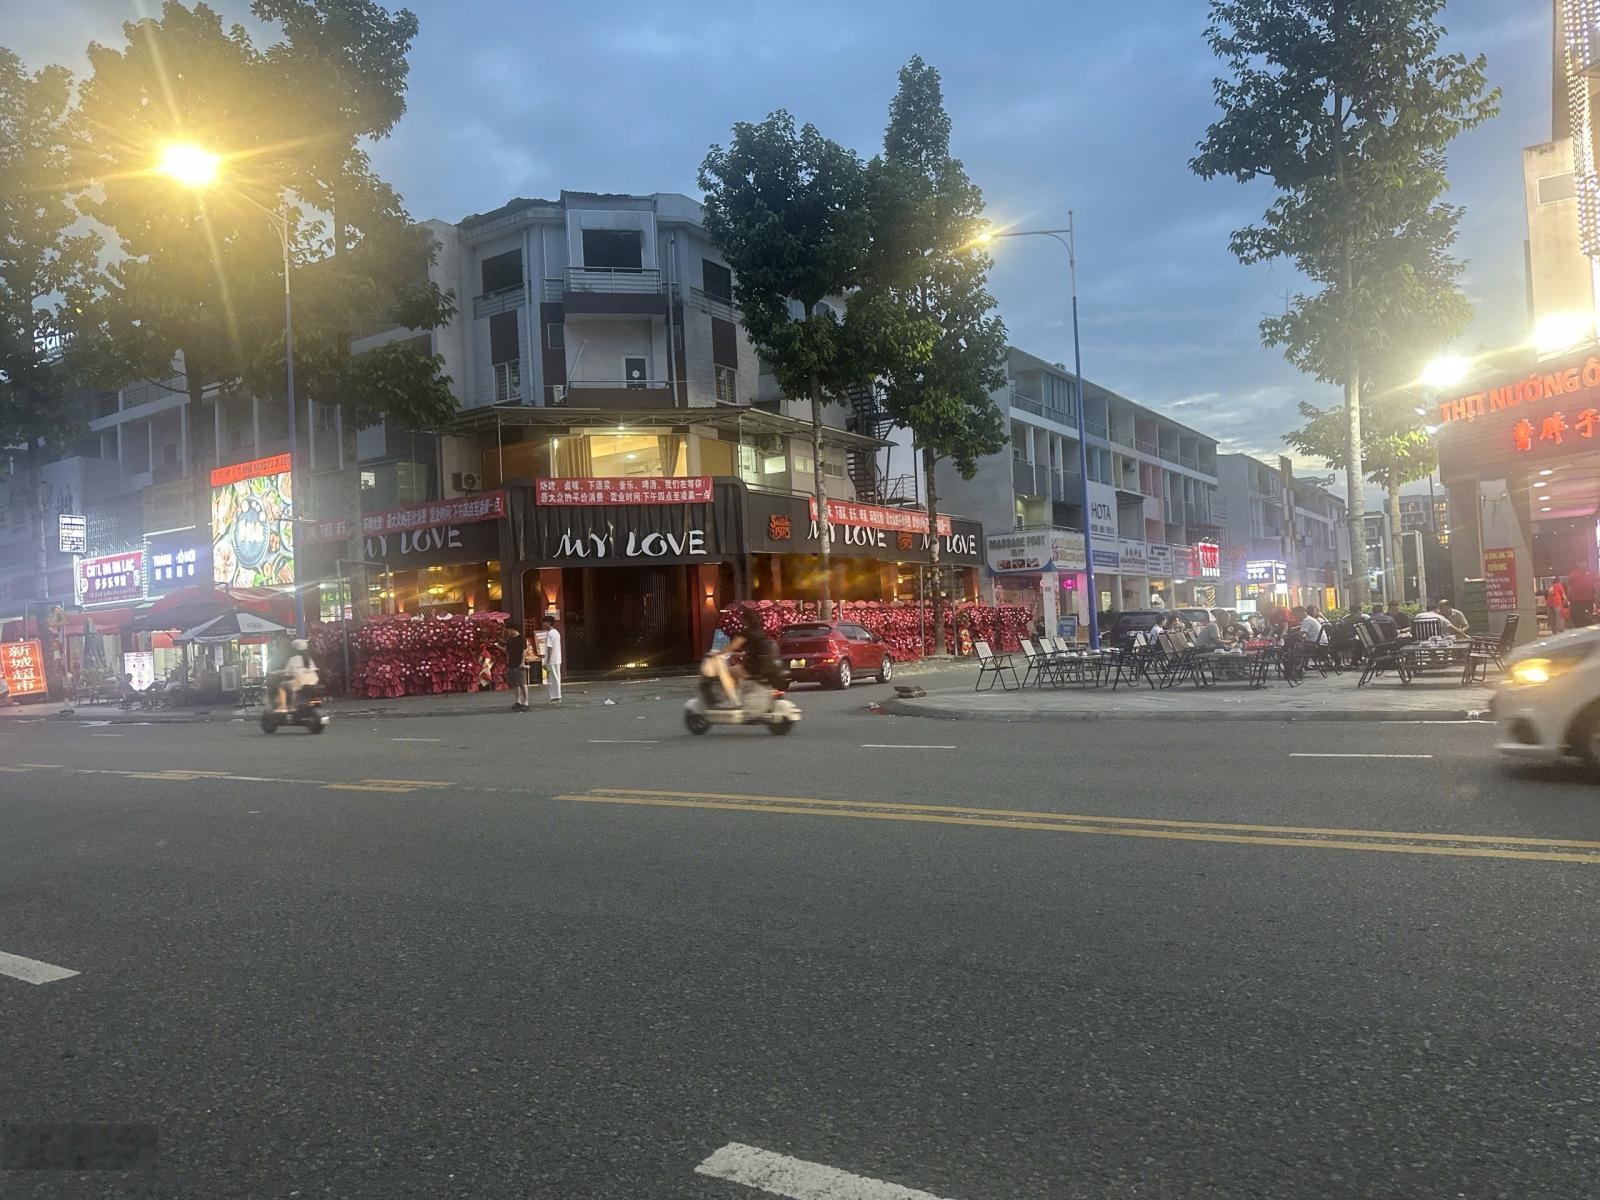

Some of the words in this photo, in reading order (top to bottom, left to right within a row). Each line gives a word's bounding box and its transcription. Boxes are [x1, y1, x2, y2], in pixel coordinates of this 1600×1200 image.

[1440, 393, 1486, 424] THỊT
[1490, 367, 1580, 412] NƯỚNG
[1091, 502, 1112, 520] HOTA
[401, 526, 462, 554] LOVE
[553, 532, 608, 558] MY
[626, 529, 707, 556] LOVE
[844, 524, 887, 548] LOVE
[946, 533, 977, 555] LOVE
